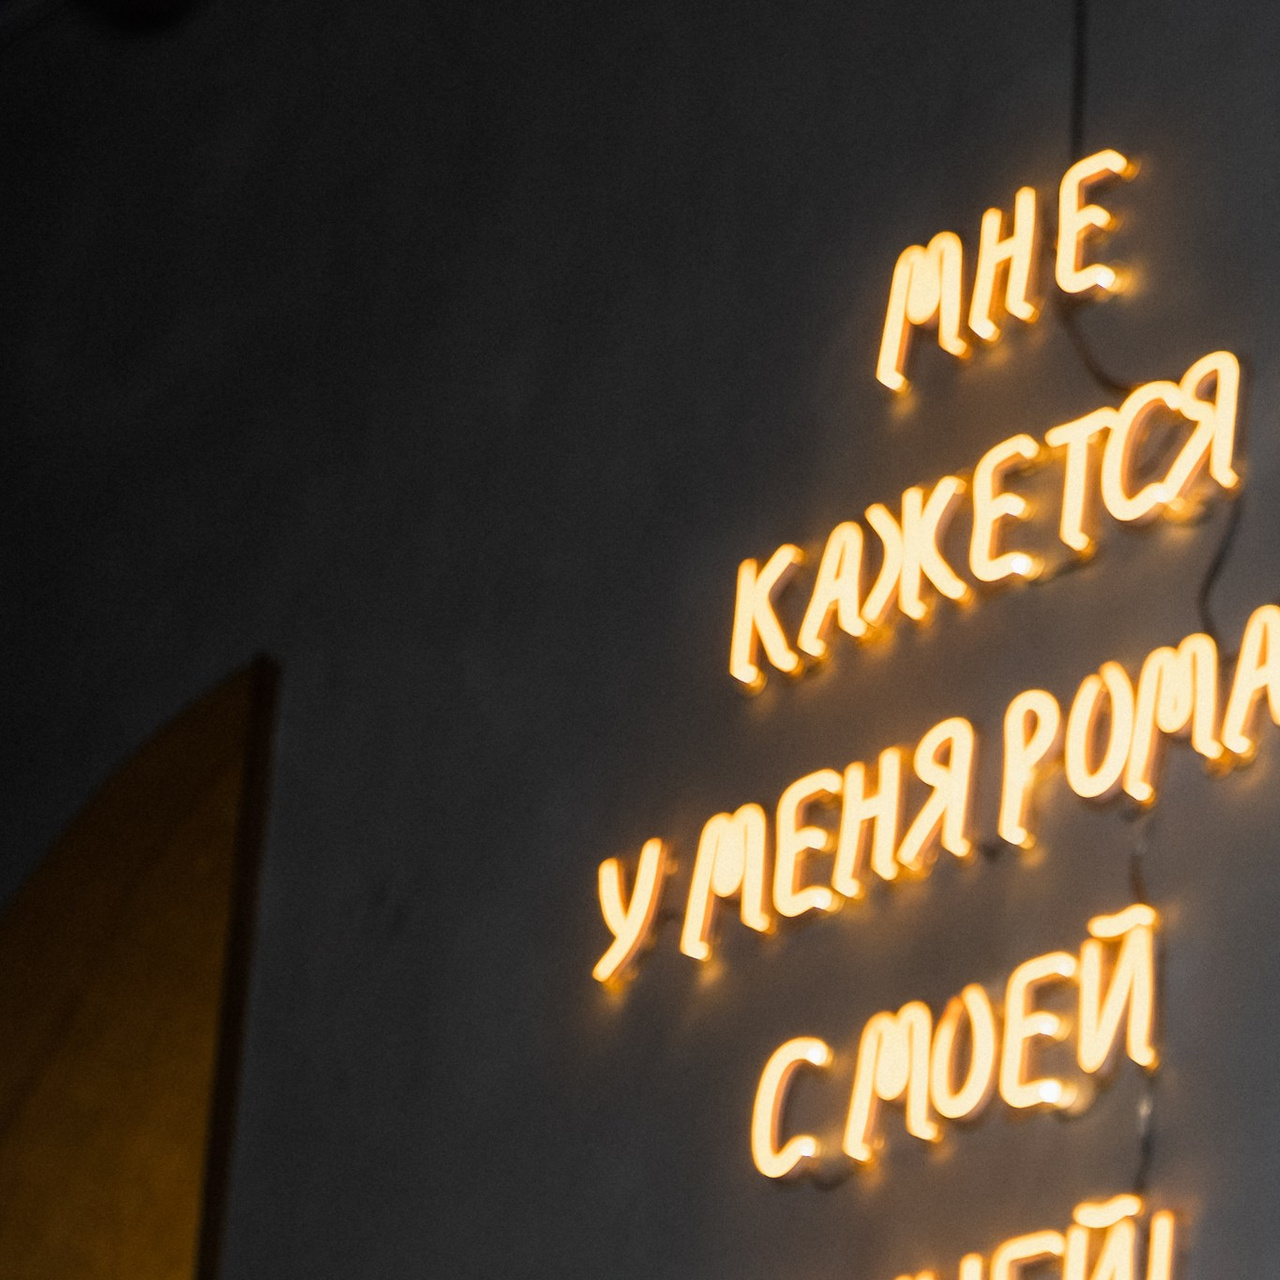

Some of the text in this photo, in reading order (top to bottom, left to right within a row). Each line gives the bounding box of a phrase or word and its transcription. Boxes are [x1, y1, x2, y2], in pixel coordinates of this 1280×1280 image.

[877, 149, 1136, 391] МНЕ
[730, 351, 1242, 688] КАЖЕТСЯ
[592, 838, 664, 985] У
[680, 717, 976, 961] МЕНЯ
[752, 903, 1159, 1178] С МОЕЙ
